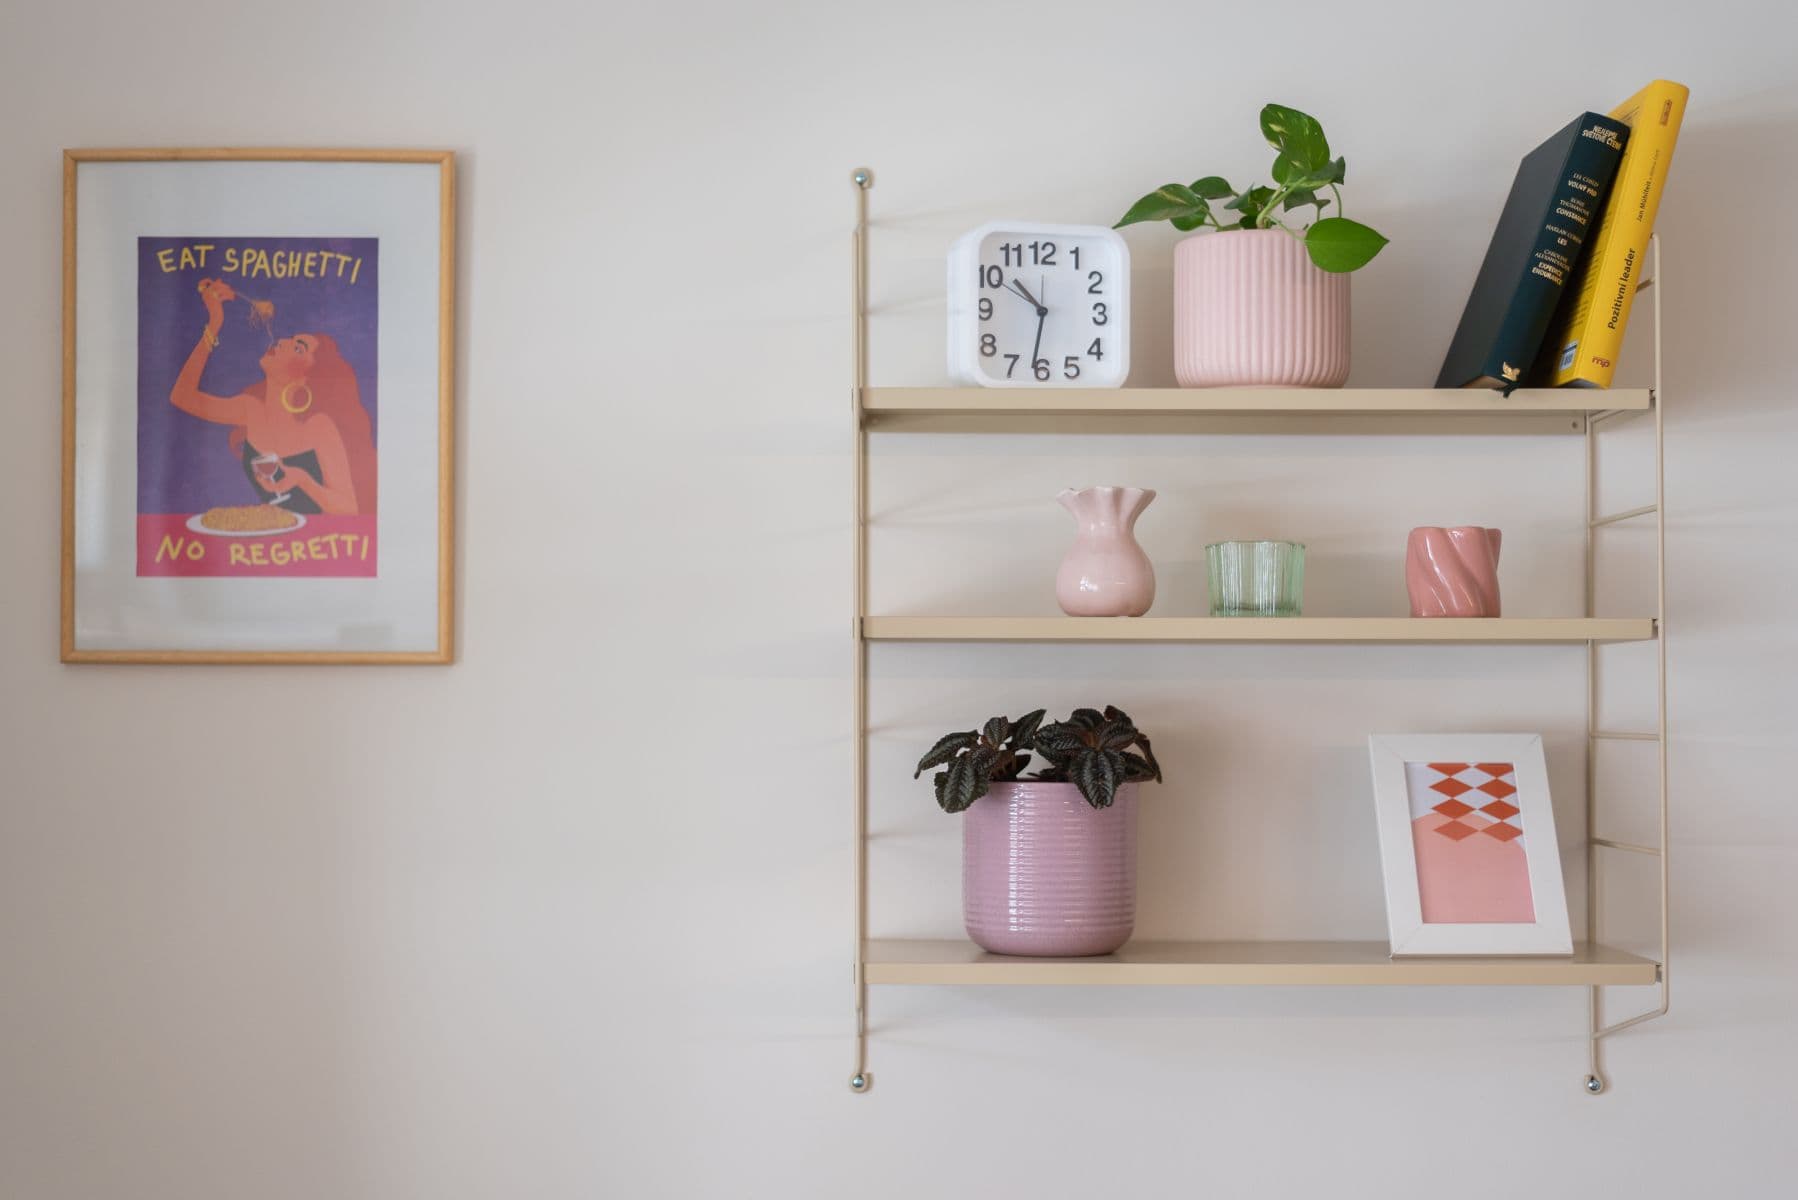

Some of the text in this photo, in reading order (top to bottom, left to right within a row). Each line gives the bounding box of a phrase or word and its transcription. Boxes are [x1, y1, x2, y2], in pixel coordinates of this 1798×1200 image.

[1637, 209, 1645, 222] Jan
[157, 244, 363, 285] EAT SPAGHETTI
[1000, 241, 1079, 270] 11 12 1
[1619, 248, 1636, 284] leader
[979, 264, 1103, 294] 10 2
[978, 297, 1108, 326] 9 3
[980, 333, 1103, 361] 8 4
[1003, 353, 1080, 382] 7 6 5
[154, 533, 370, 566] NO REGRETTI
